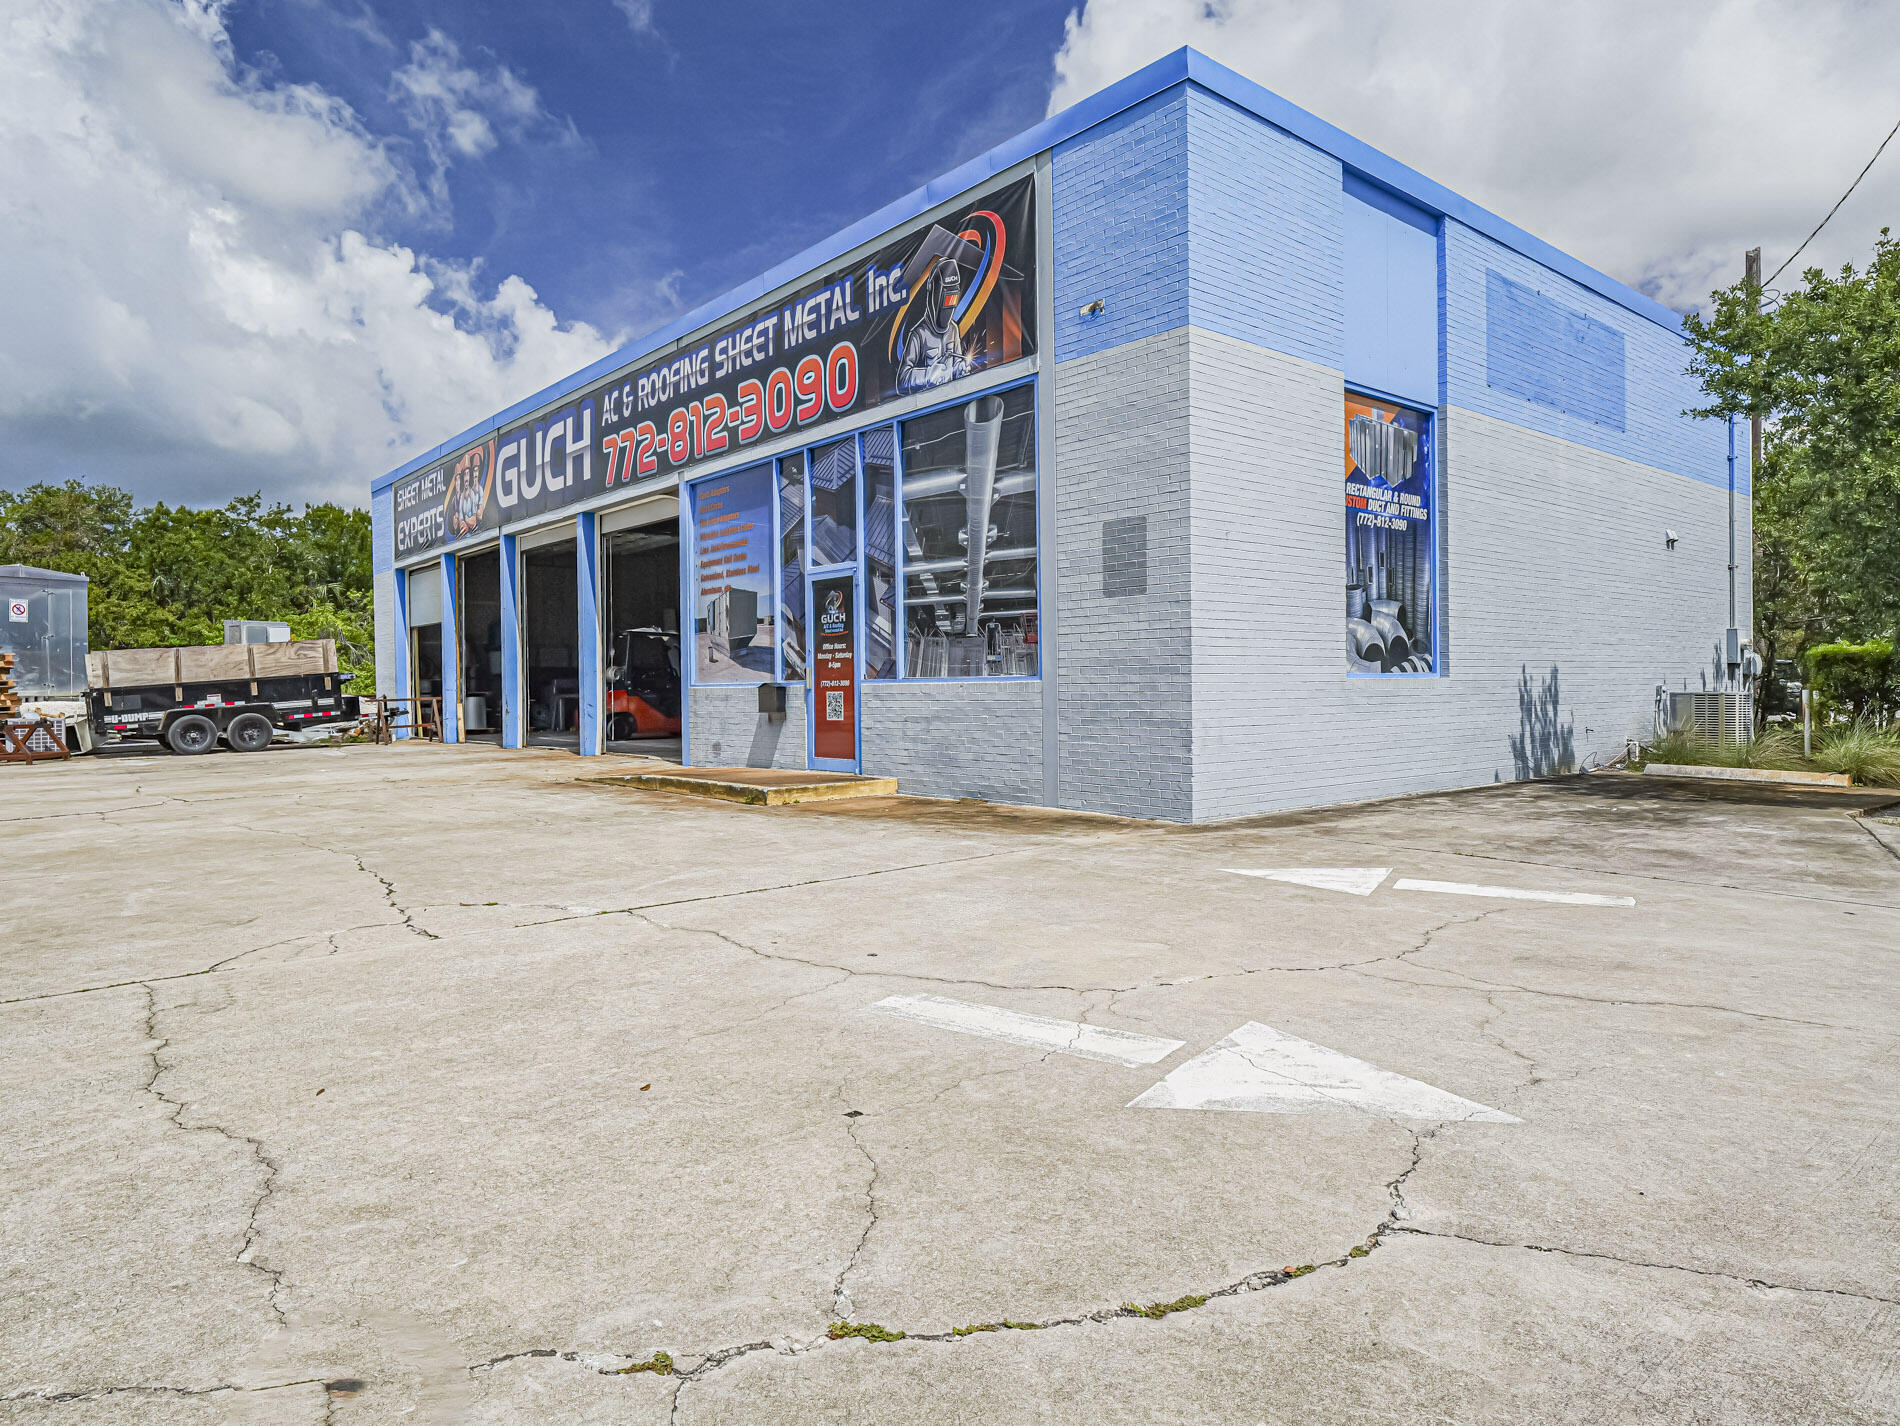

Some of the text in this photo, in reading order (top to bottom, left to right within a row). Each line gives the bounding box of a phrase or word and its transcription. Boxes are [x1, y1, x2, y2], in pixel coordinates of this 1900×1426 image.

[602, 267, 908, 426] AC & ROOFING SHEET METAL Inc.
[603, 341, 859, 488] 772-812-3090
[496, 408, 591, 508] GUCH
[397, 468, 447, 512] SHEET METAL
[1346, 482, 1421, 507] RECTANGULAR & ROUND
[1368, 498, 1386, 513] DUCT
[1386, 502, 1400, 516] AND
[1401, 505, 1428, 520] FITTINGS
[397, 504, 445, 551] EXPERTS
[1357, 511, 1408, 531] (772)-812-3090
[821, 612, 846, 623] GUCH
